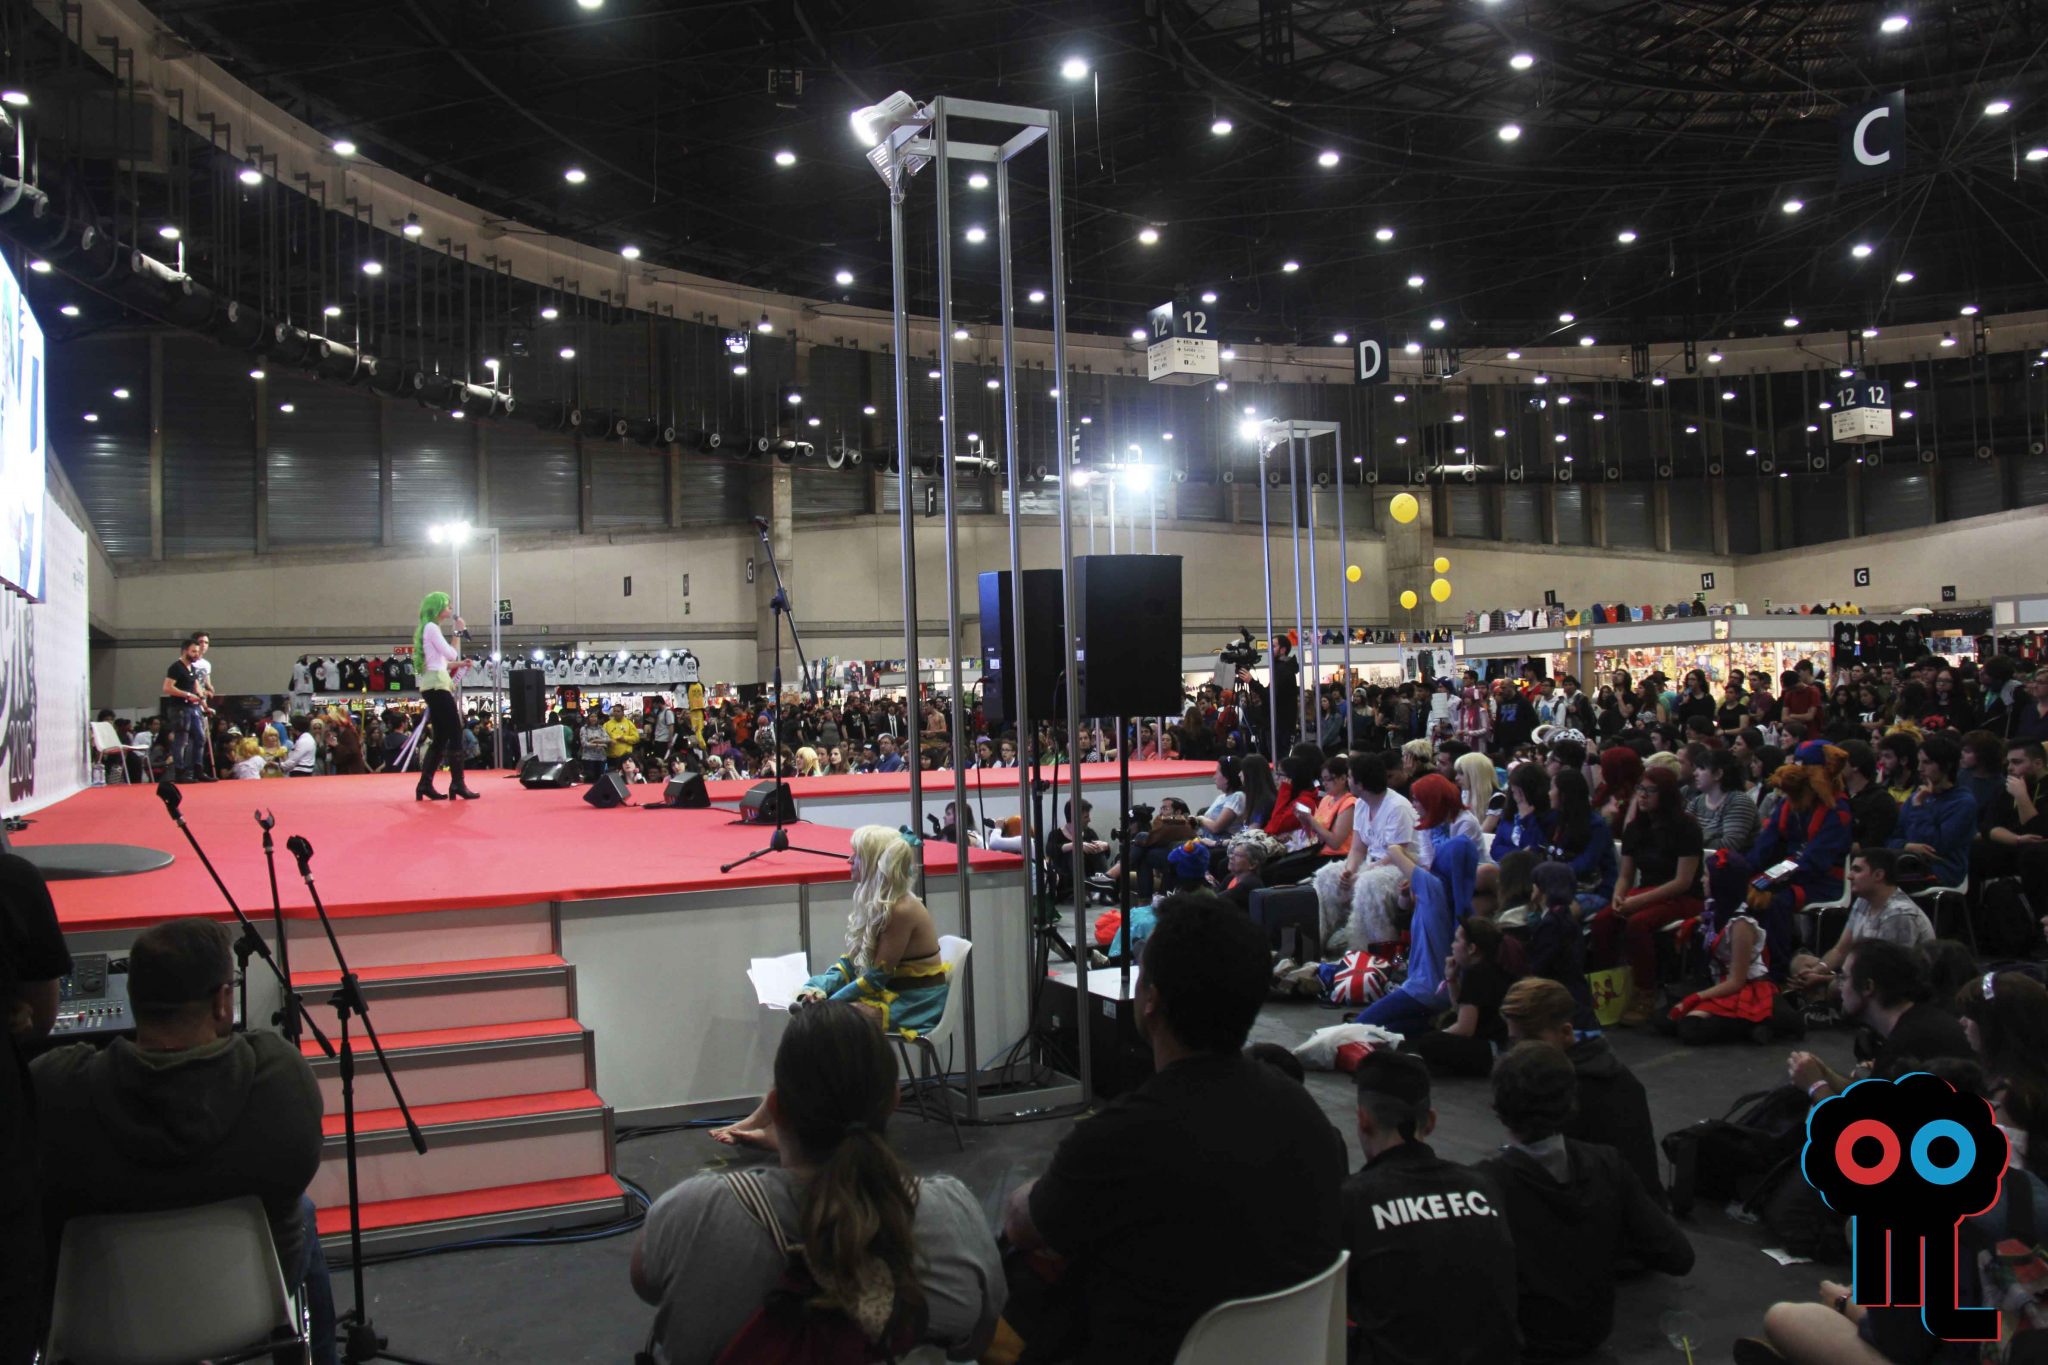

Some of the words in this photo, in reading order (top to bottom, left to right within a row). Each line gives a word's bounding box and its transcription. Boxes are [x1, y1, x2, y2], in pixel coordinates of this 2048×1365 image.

[1853, 107, 1890, 166] C
[1152, 314, 1168, 338] 12
[1182, 311, 1208, 334] 12
[1360, 340, 1381, 379] D
[1837, 387, 1856, 407] 12
[1868, 386, 1886, 405] 12
[1071, 434, 1081, 465] E
[928, 486, 934, 513] F
[747, 561, 753, 580] G
[1703, 574, 1713, 588] H
[1856, 570, 1867, 584] G
[1371, 1194, 1449, 1231] NIKE
[1446, 1190, 1498, 1217] F.C.
